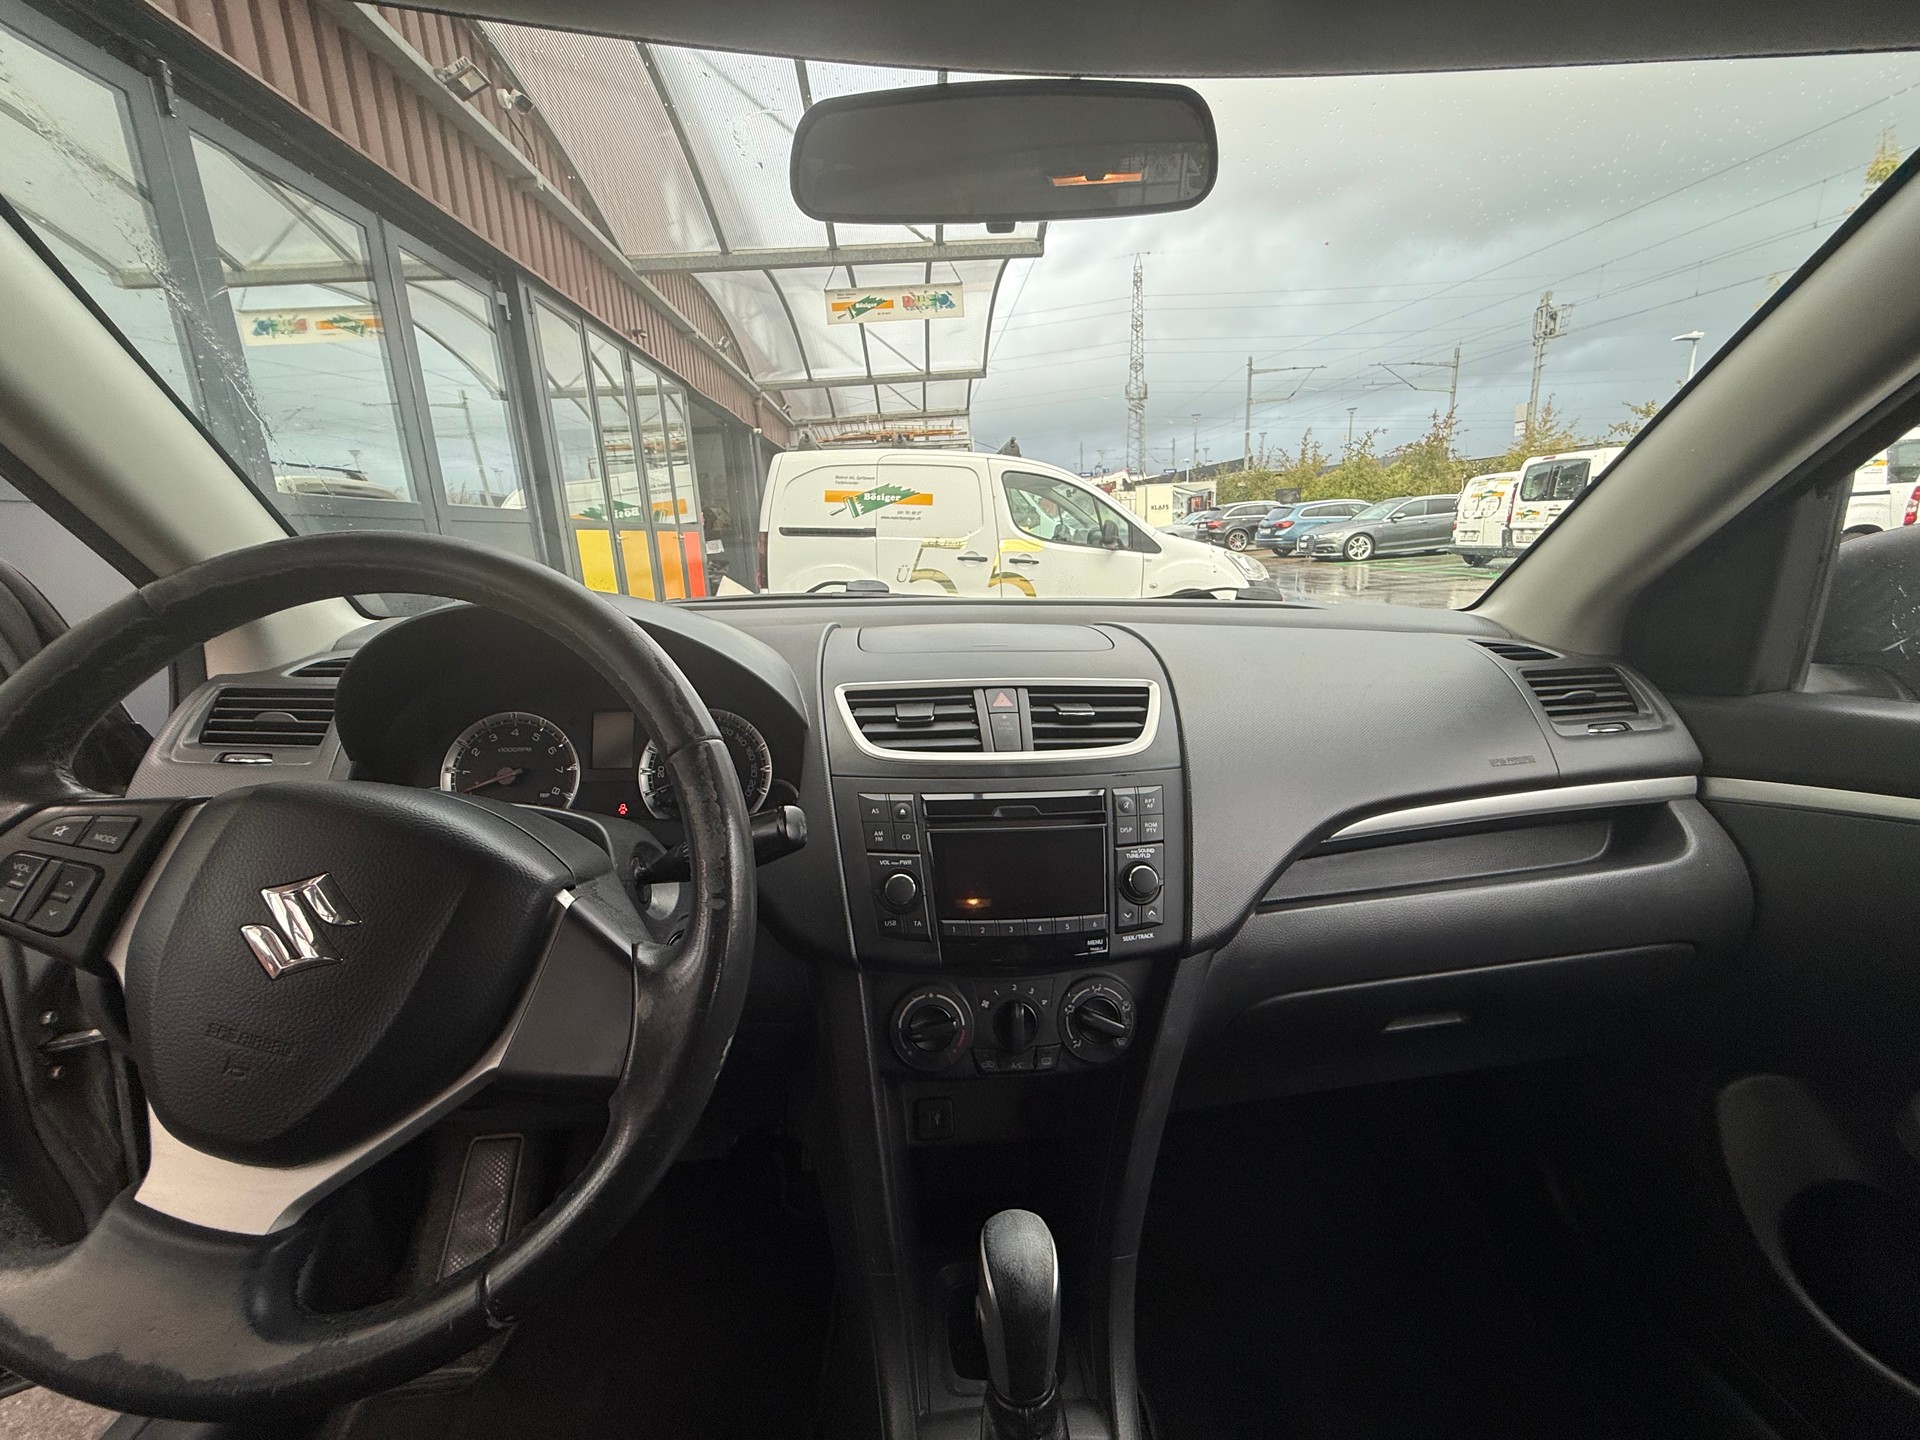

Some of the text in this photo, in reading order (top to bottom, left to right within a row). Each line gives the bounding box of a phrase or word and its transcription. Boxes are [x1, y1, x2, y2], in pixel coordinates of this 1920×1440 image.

[863, 493, 902, 503] Bösiger
[1150, 503, 1170, 511] KLAFS
[511, 728, 520, 737] 4
[531, 732, 542, 742] 5
[489, 733, 499, 743] 3
[471, 746, 481, 757] 2
[547, 746, 557, 756] 6
[555, 765, 564, 774] 7
[657, 765, 665, 778] 20
[551, 786, 561, 796] 8
[871, 807, 880, 815] AS
[94, 833, 118, 844] MODE
[901, 833, 911, 841] CD
[879, 858, 891, 866] VOL
[13, 863, 30, 873] VOL
[884, 919, 897, 927] USB
[912, 919, 922, 927] TA
[1092, 920, 1097, 928] 6
[980, 926, 985, 934] 2
[1008, 925, 1014, 933] 3
[1122, 932, 1155, 942] SEEK/TRACK
[1087, 939, 1104, 947] MENU
